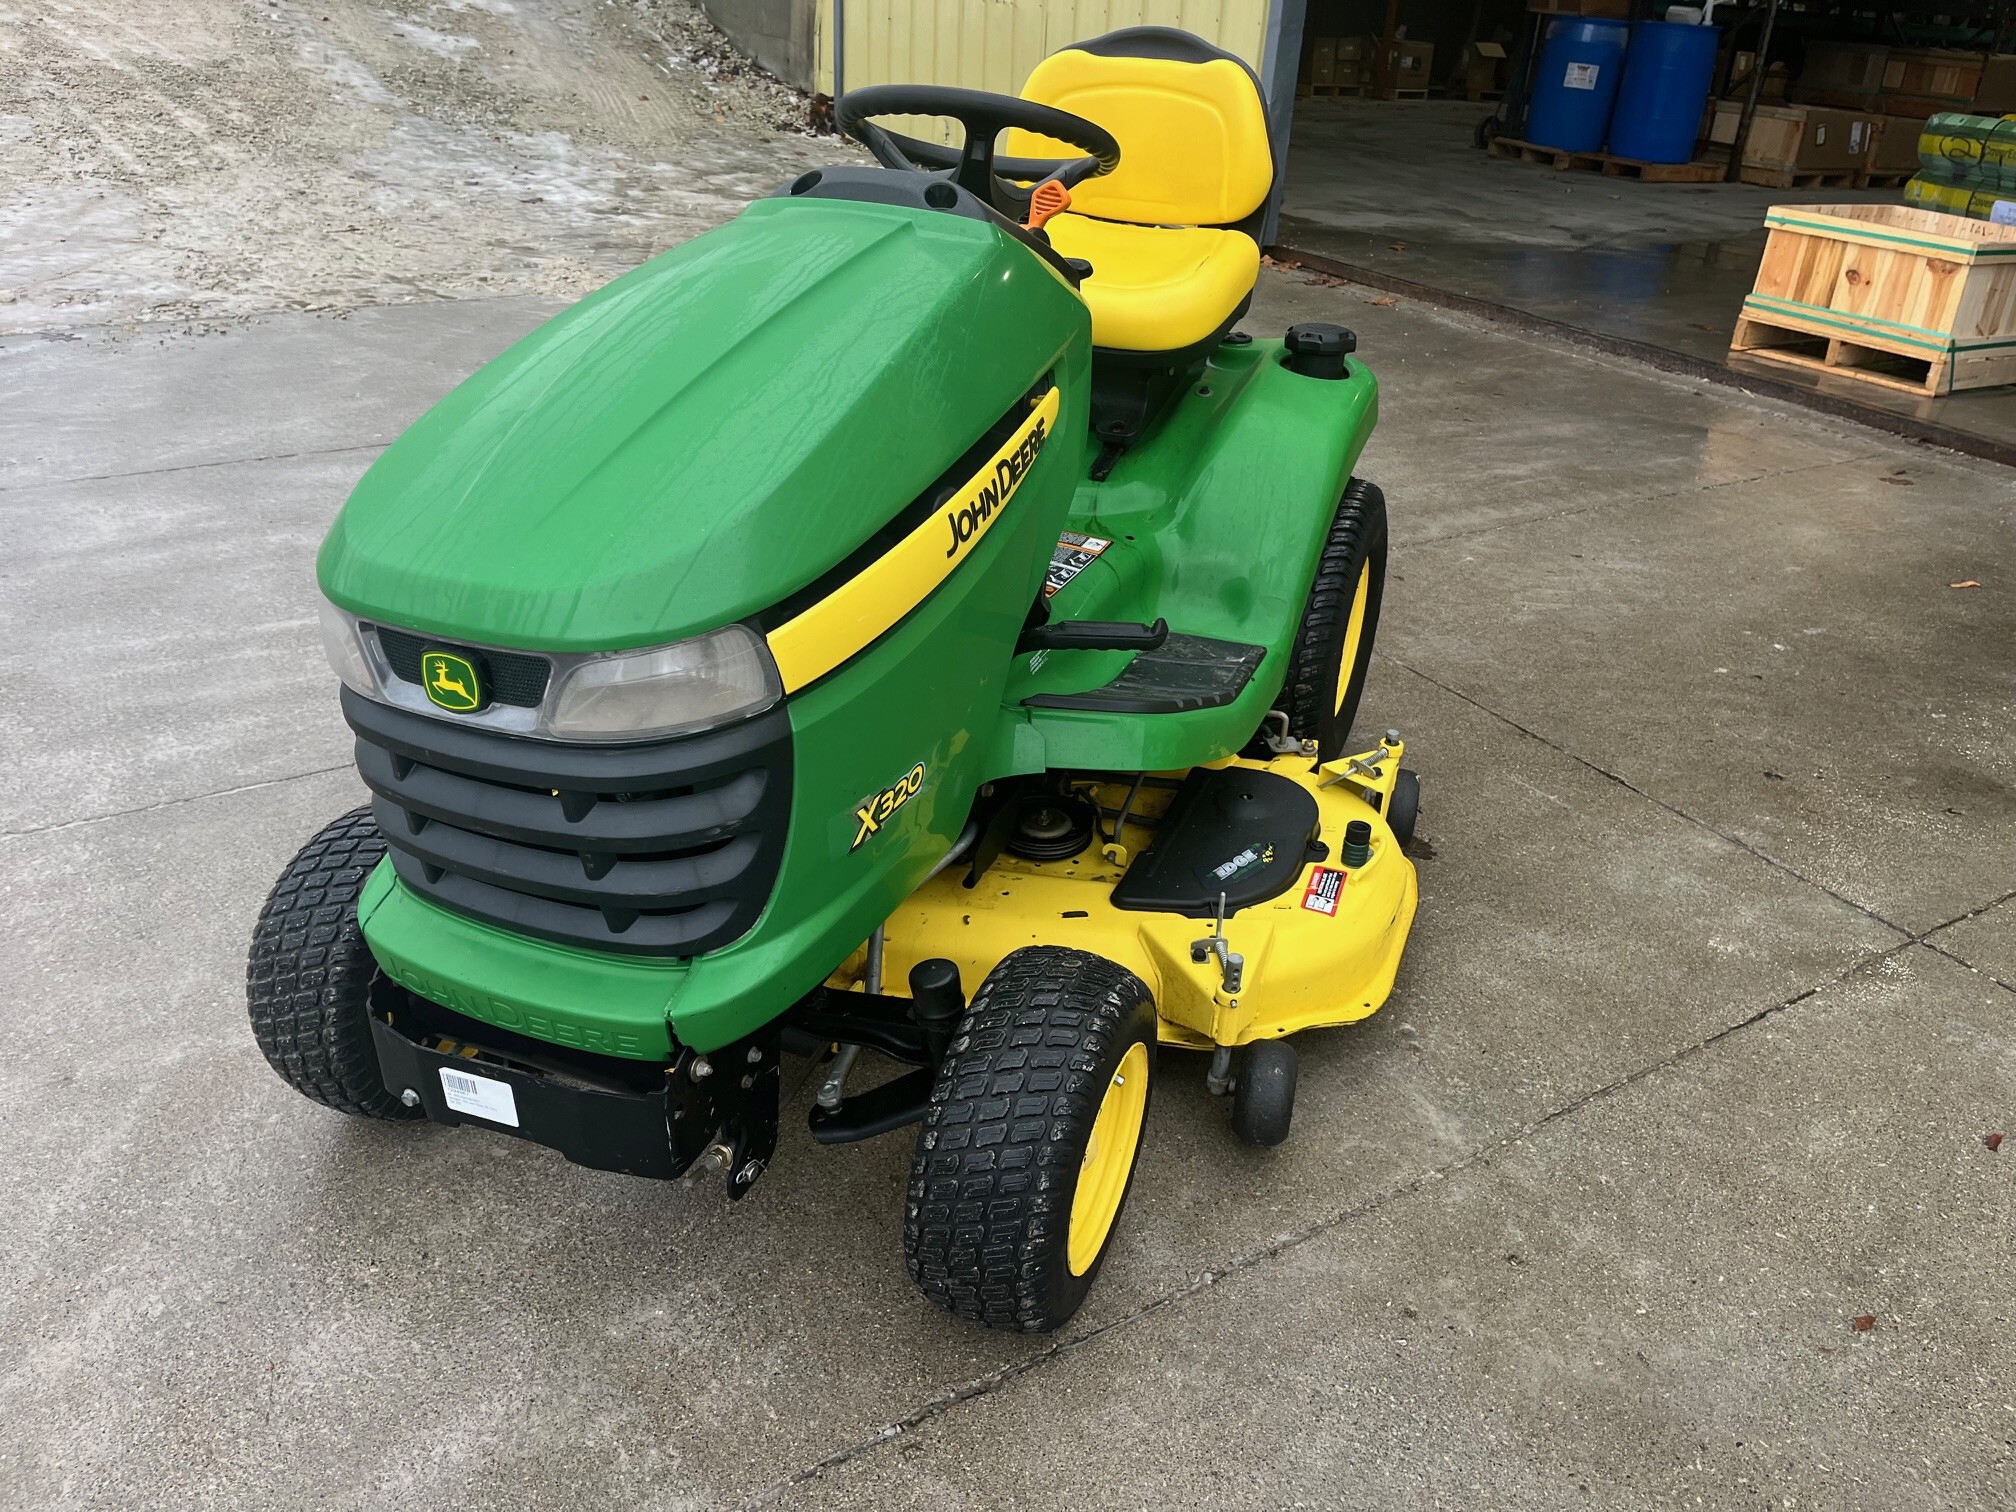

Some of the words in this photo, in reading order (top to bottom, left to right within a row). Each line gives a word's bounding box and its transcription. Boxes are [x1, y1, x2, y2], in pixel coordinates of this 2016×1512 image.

[946, 478, 999, 558] JOHN
[996, 417, 1046, 500] DEERE
[849, 763, 925, 853] X320
[1213, 849, 1258, 881] EDGE
[388, 956, 483, 1018] JOHN
[487, 995, 644, 1056] DEERE
